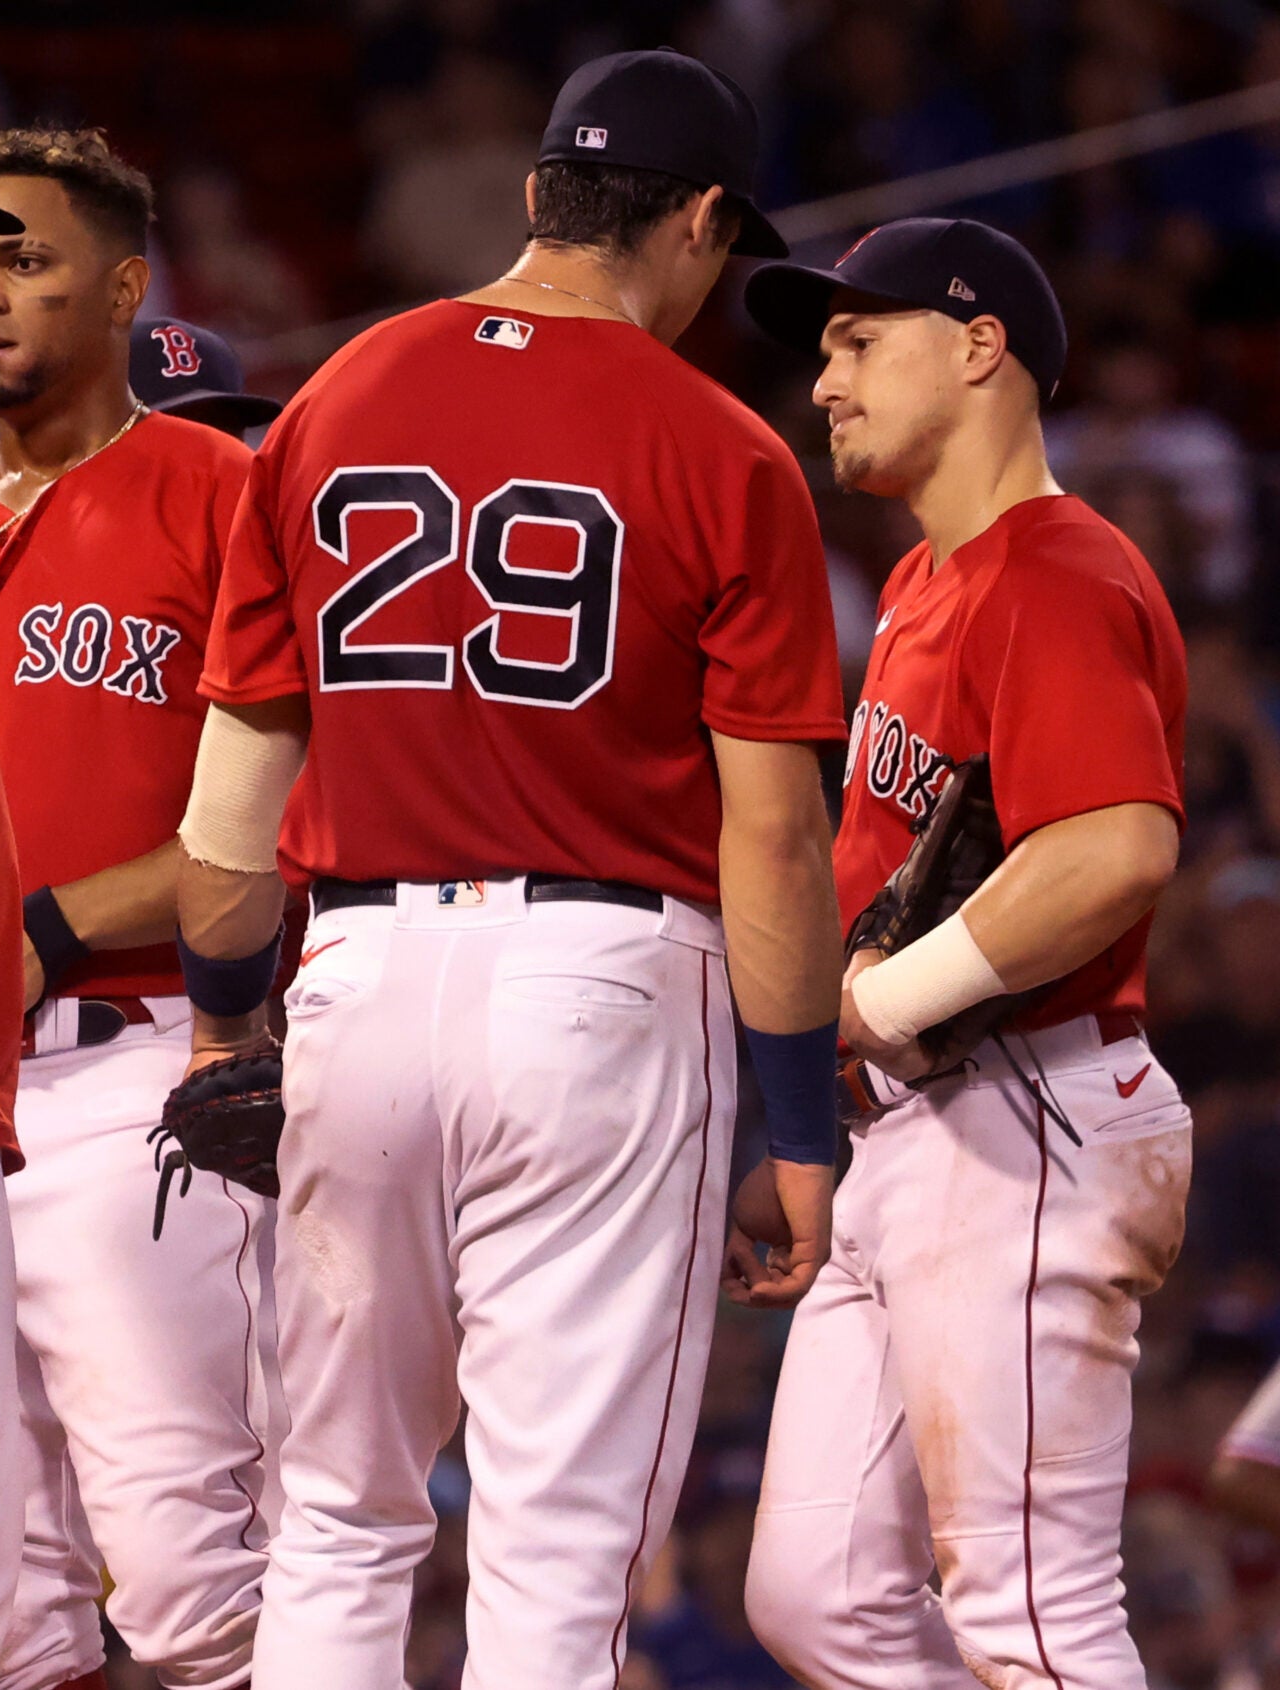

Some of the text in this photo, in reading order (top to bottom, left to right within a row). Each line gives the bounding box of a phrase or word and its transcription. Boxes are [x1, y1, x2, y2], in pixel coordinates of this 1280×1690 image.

[150, 325, 202, 378] B
[312, 465, 625, 711] 29
[14, 601, 181, 705] SOX
